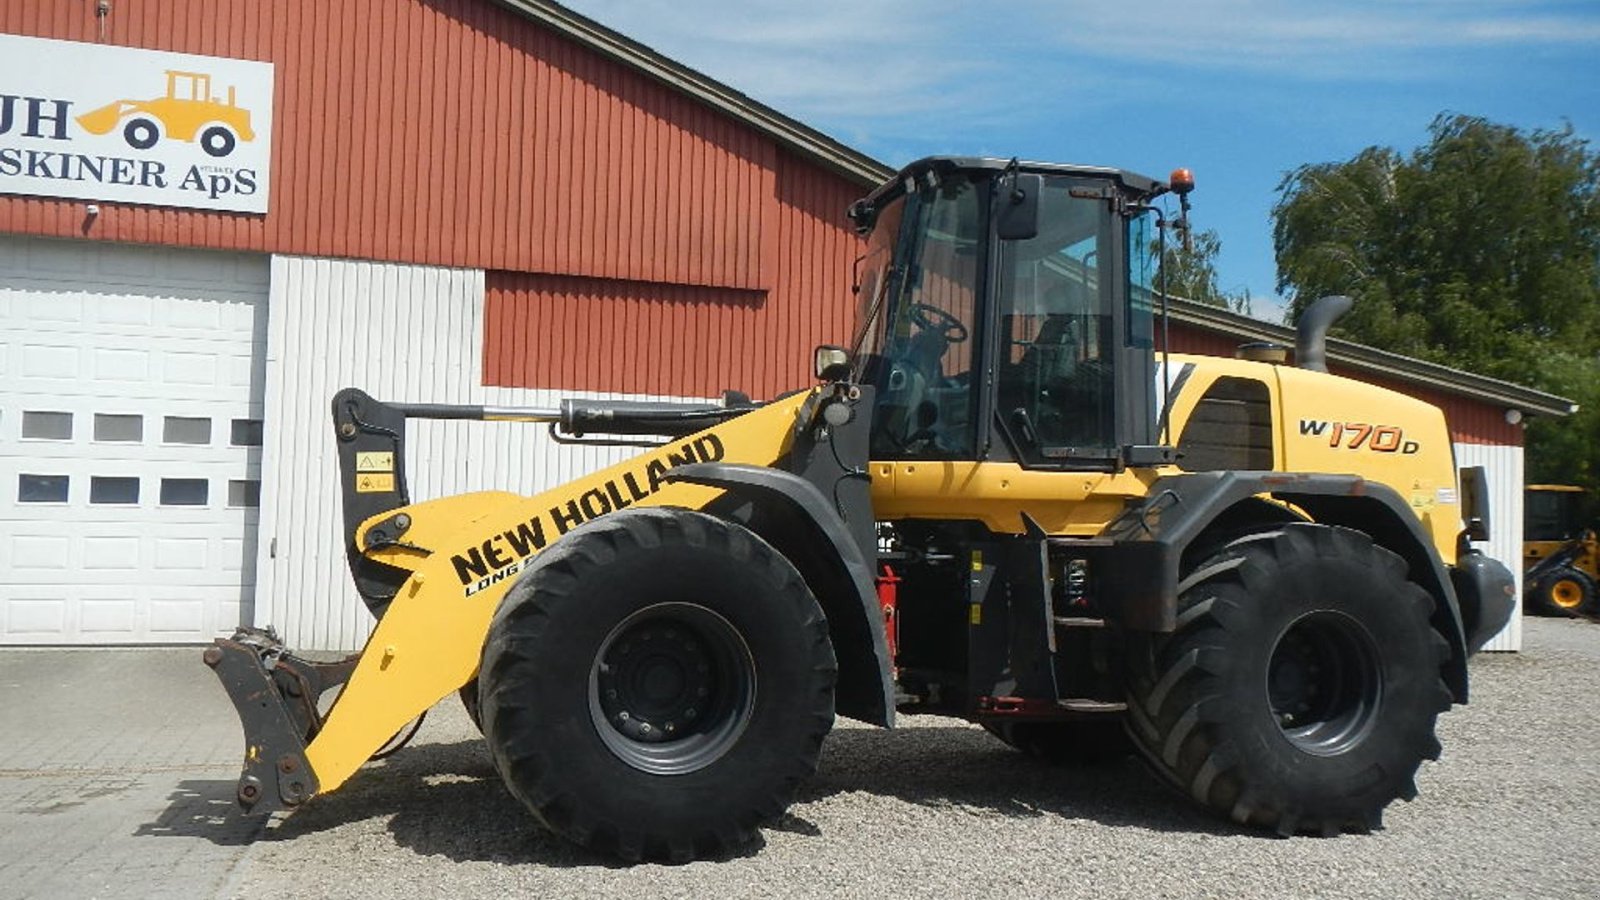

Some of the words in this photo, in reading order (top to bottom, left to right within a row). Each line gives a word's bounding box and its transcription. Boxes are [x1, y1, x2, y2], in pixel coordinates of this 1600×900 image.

[0, 148, 168, 188] SKINER
[178, 164, 256, 199] ApS
[450, 516, 547, 585] NEW
[550, 433, 725, 535] HOLLAND
[465, 563, 518, 597] LONG
